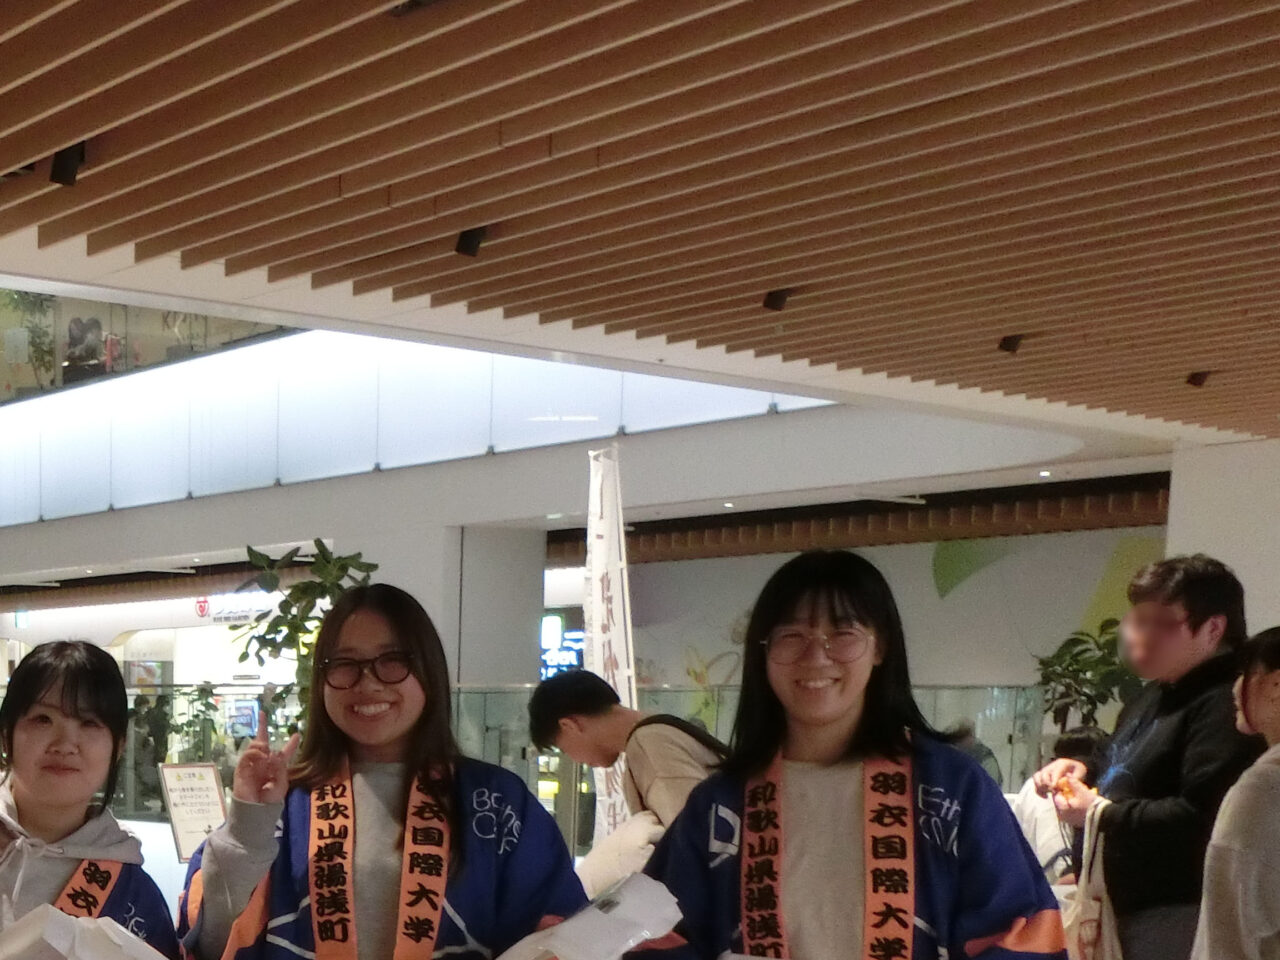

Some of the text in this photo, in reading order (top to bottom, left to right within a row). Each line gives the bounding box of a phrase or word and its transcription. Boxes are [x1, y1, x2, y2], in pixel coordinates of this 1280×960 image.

[61, 862, 112, 917] 羽衣
[314, 783, 351, 943] 和歌山県湯浅町
